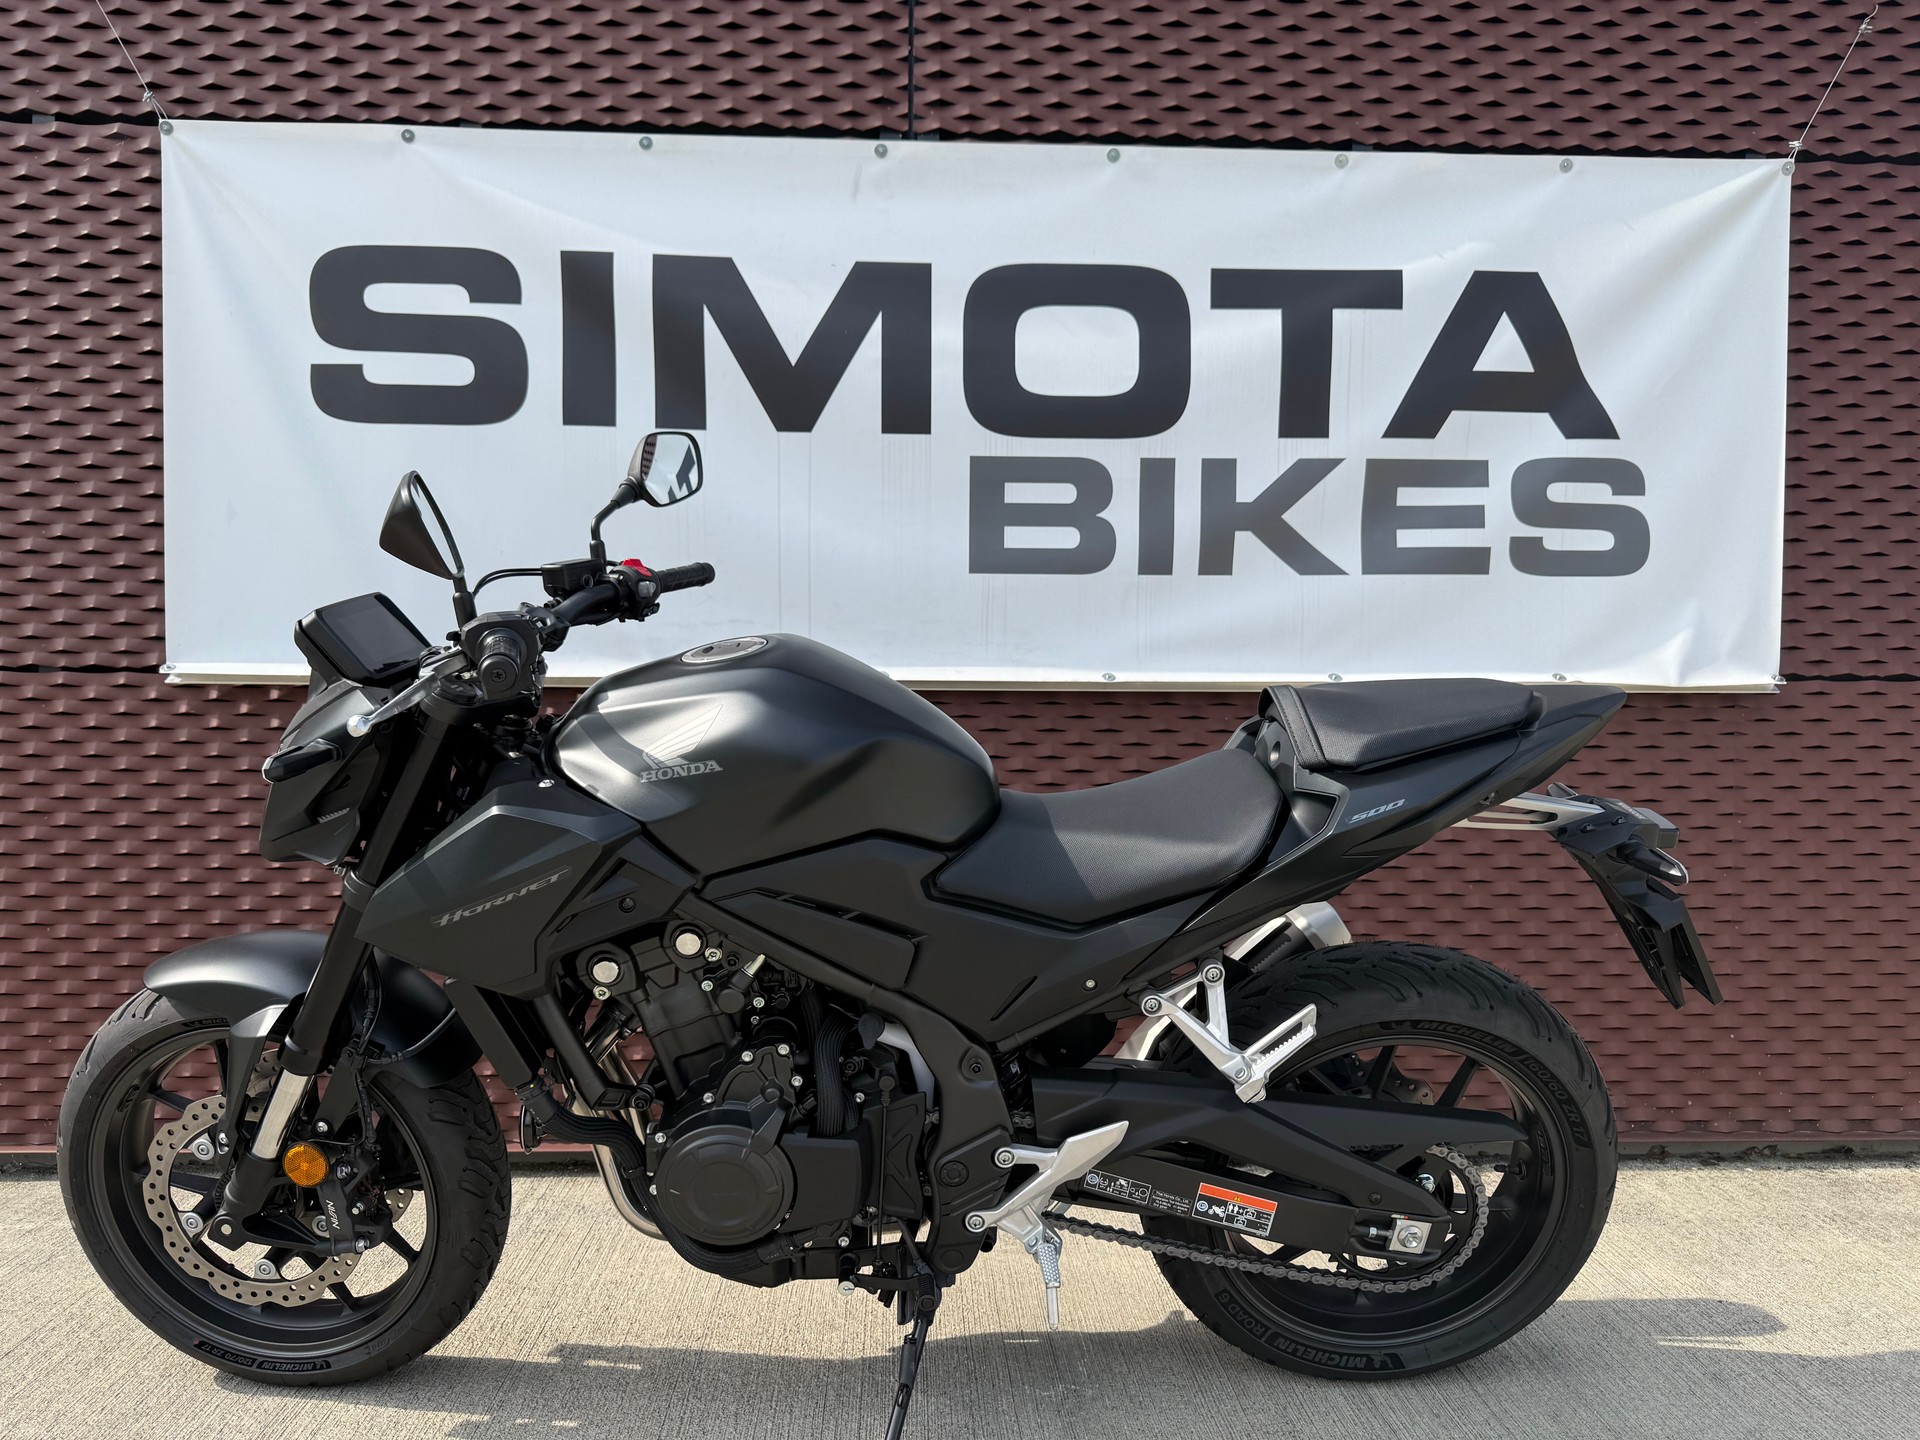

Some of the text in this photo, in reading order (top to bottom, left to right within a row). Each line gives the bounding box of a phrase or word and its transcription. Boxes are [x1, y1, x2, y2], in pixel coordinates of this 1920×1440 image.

[310, 245, 1620, 439] SIMOTA
[969, 456, 1651, 576] BIKES
[640, 759, 723, 783] HONDA
[1349, 798, 1406, 824] 500
[1418, 1021, 1587, 1143] MICHELIN 160/60 ZR 17
[325, 1199, 341, 1230] NISSIN
[200, 1342, 315, 1372] MICHELIN 120/70 ZR 17
[1219, 1293, 1368, 1369] MICHELIN ROAD 6
